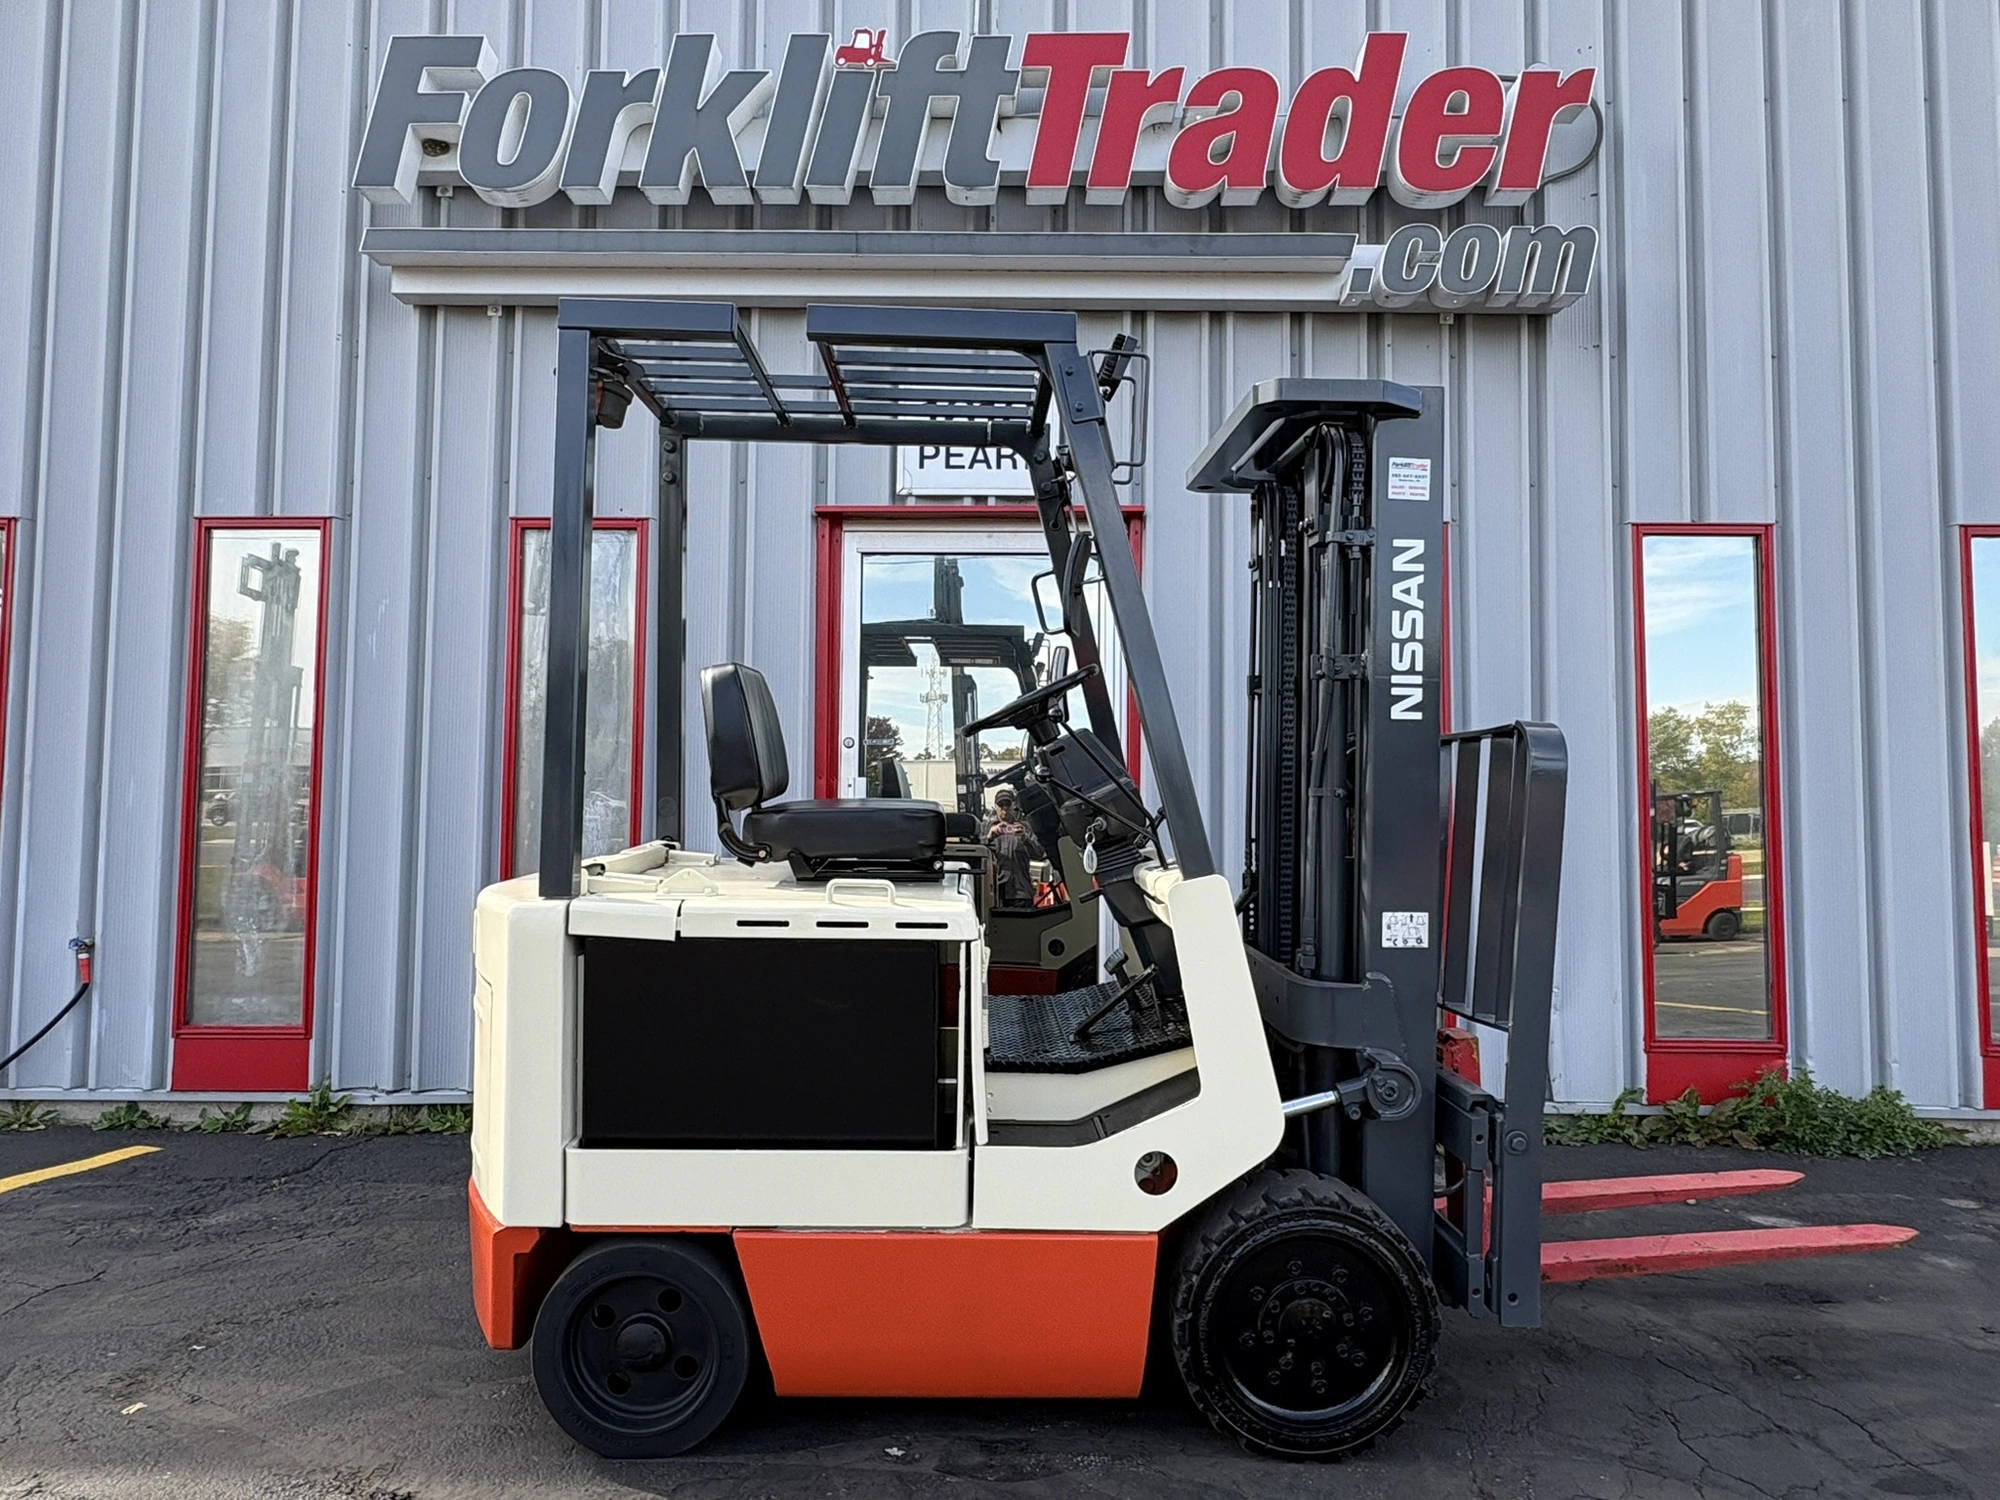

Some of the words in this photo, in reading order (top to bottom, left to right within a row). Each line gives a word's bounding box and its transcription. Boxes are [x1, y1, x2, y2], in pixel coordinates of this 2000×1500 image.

[1348, 223, 1599, 298] .com
[918, 445, 1030, 470] PEAR
[1390, 538, 1425, 720] NISSAN
